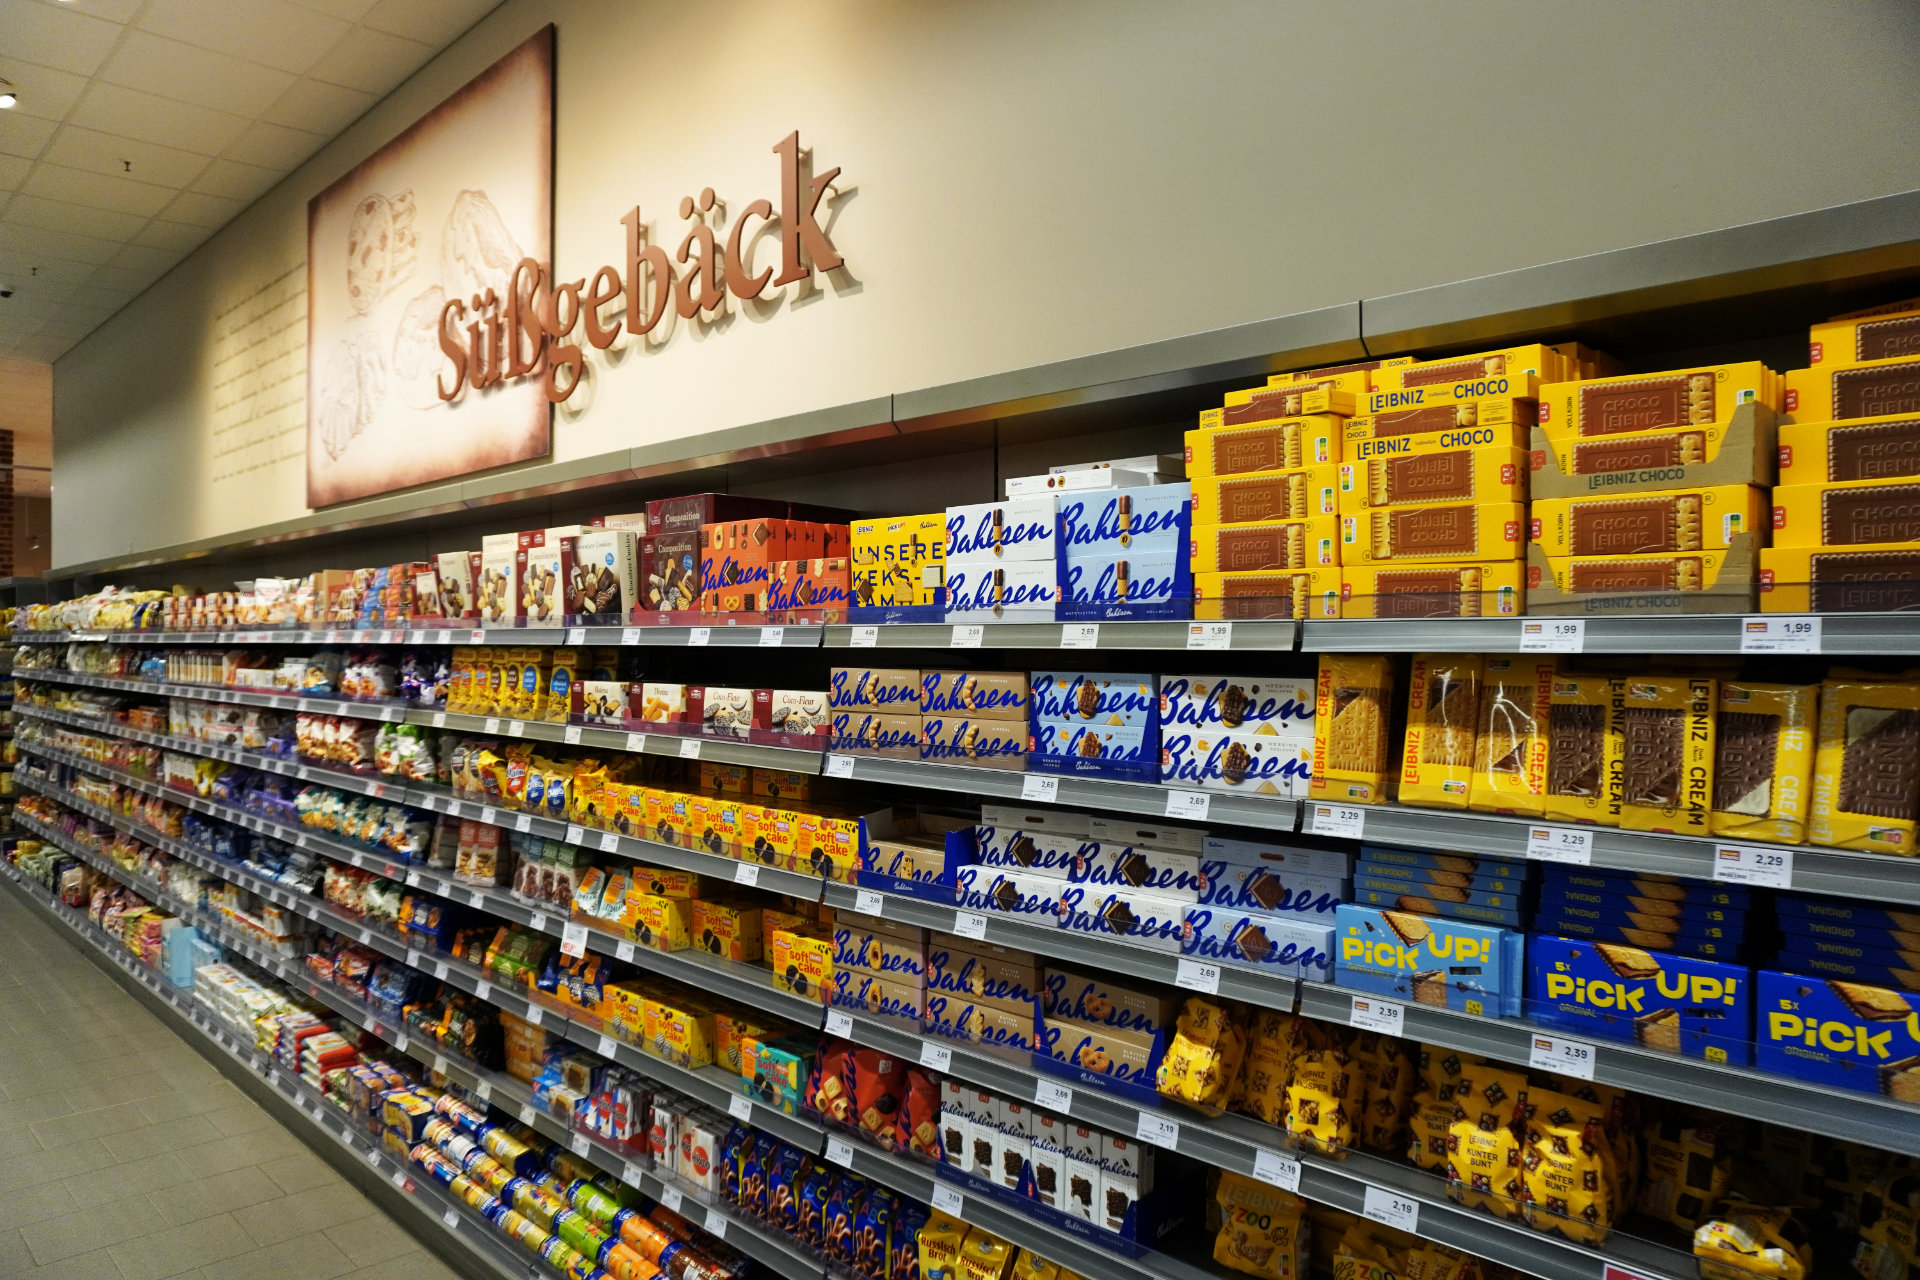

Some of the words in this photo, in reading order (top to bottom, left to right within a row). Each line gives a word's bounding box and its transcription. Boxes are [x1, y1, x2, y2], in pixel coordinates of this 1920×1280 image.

[437, 130, 844, 402] Süßgebäck
[1370, 390, 1424, 413] LEIBNIZ
[1454, 379, 1508, 399] CHOCO
[1603, 396, 1660, 412] CHOCO
[1345, 419, 1368, 430] LEIBNIZ
[1603, 412, 1661, 432] LEIBNIZ
[1346, 430, 1367, 439] CHOCO
[1357, 438, 1411, 460] LEIBNIZ
[1440, 429, 1494, 448] CHOCO
[1595, 454, 1653, 470] CHOCO
[1589, 472, 1636, 490] LEIBNIZ
[1639, 468, 1685, 482] CHOCO
[665, 511, 700, 522] Composition
[1592, 516, 1648, 531] CHOCO
[658, 543, 692, 554] Composition
[1593, 531, 1649, 551] LEIBNIZ
[852, 542, 943, 563] UNSERE
[701, 556, 768, 592] Bahsen
[852, 568, 920, 587] KEKS-
[768, 575, 850, 610] Bahsen
[1106, 607, 1132, 618] Bahlsen
[1585, 597, 1634, 612] LEIBNIZ
[1636, 596, 1681, 608] CHOCO
[1210, 626, 1227, 636] 1,99
[1554, 624, 1577, 635] 1,99
[1783, 622, 1812, 634] 1,99
[1317, 668, 1332, 717] CREAM
[1412, 660, 1427, 710] CREAM
[1536, 664, 1552, 720] LEIBNIZ
[782, 695, 814, 705] Coco-Fleur
[1032, 674, 1149, 716] Bahsen
[1160, 679, 1316, 726] Bahsen
[1608, 677, 1624, 736] LEIBNIZ
[1689, 679, 1710, 742] LEIBNIZ
[1040, 726, 1141, 760] Bahse
[1161, 734, 1312, 781] Bahsen
[1312, 737, 1326, 789] LEIBNIZ
[1404, 730, 1421, 784] LEIBNIZ
[1528, 741, 1546, 796] CREAM
[1609, 759, 1624, 816] CREAM
[1689, 766, 1707, 826] CREAM
[660, 805, 674, 814] soft
[1190, 797, 1204, 806] 2,69
[1776, 776, 1800, 838] CREAM
[1812, 774, 1833, 842] LEIBNIZ
[666, 814, 684, 825] cake
[706, 812, 722, 822] soft
[1340, 811, 1358, 820] 2,29
[714, 824, 734, 834] cake
[758, 821, 776, 832] soft
[766, 832, 788, 844] cake
[815, 831, 835, 844] soft
[1562, 834, 1584, 845] 2,29
[824, 844, 848, 856] cake
[976, 827, 1077, 869] Bahsen
[868, 847, 944, 886] Bahse
[1077, 842, 1200, 891] Bahsen
[1755, 854, 1784, 866] 2,29
[957, 868, 1060, 916] Bahsen
[1200, 861, 1336, 914] Bahsen
[638, 906, 652, 916] soft
[1058, 888, 1184, 942] Bahsen
[644, 916, 662, 928] cake
[706, 916, 721, 926] soft
[713, 926, 732, 938] cake
[1183, 910, 1334, 970] Bahsen
[789, 950, 808, 962] soft
[833, 929, 924, 976] Bahsen
[1428, 932, 1491, 963] UP!
[798, 962, 822, 976] cake
[928, 952, 1036, 1003] Bahsen
[1200, 968, 1216, 978] 2,69
[831, 972, 924, 1020] Bahsen
[1656, 970, 1737, 1006] UP!
[1044, 974, 1160, 1034] Bahsen
[1379, 1006, 1398, 1018] 2,39
[1559, 1003, 1597, 1018] ORIGINAL
[658, 1020, 673, 1032] soft
[924, 997, 1034, 1050] Bahsen
[664, 1030, 682, 1044] cake
[1046, 1028, 1146, 1081] Bahse
[1565, 1047, 1588, 1059] 2,39
[1784, 1046, 1830, 1063] ORIGINAL
[968, 1112, 1000, 1130] Bahlsen
[1160, 1122, 1174, 1134] 2,19
[998, 1122, 1033, 1142] Bahlsen
[1031, 1135, 1066, 1154] Bahlsen
[1469, 1134, 1498, 1148] LEIBNIZ
[1064, 1146, 1102, 1166] Bahlsen
[1466, 1148, 1498, 1162] KUNTER
[1470, 1158, 1492, 1169] BUNT
[1100, 1158, 1140, 1180] Bahlsen
[1280, 1163, 1296, 1175] 2,19
[968, 1180, 991, 1193] Bahlsen
[1542, 1170, 1574, 1186] KUNTER
[1546, 1180, 1568, 1193] BUNT
[1392, 1201, 1412, 1214] 2,19
[1064, 1220, 1090, 1235] Bahlsen
[1235, 1208, 1272, 1230] ZOO
[920, 1237, 957, 1256] Russisch
[928, 1249, 948, 1262] Brot
[960, 1256, 998, 1280] Russisch
